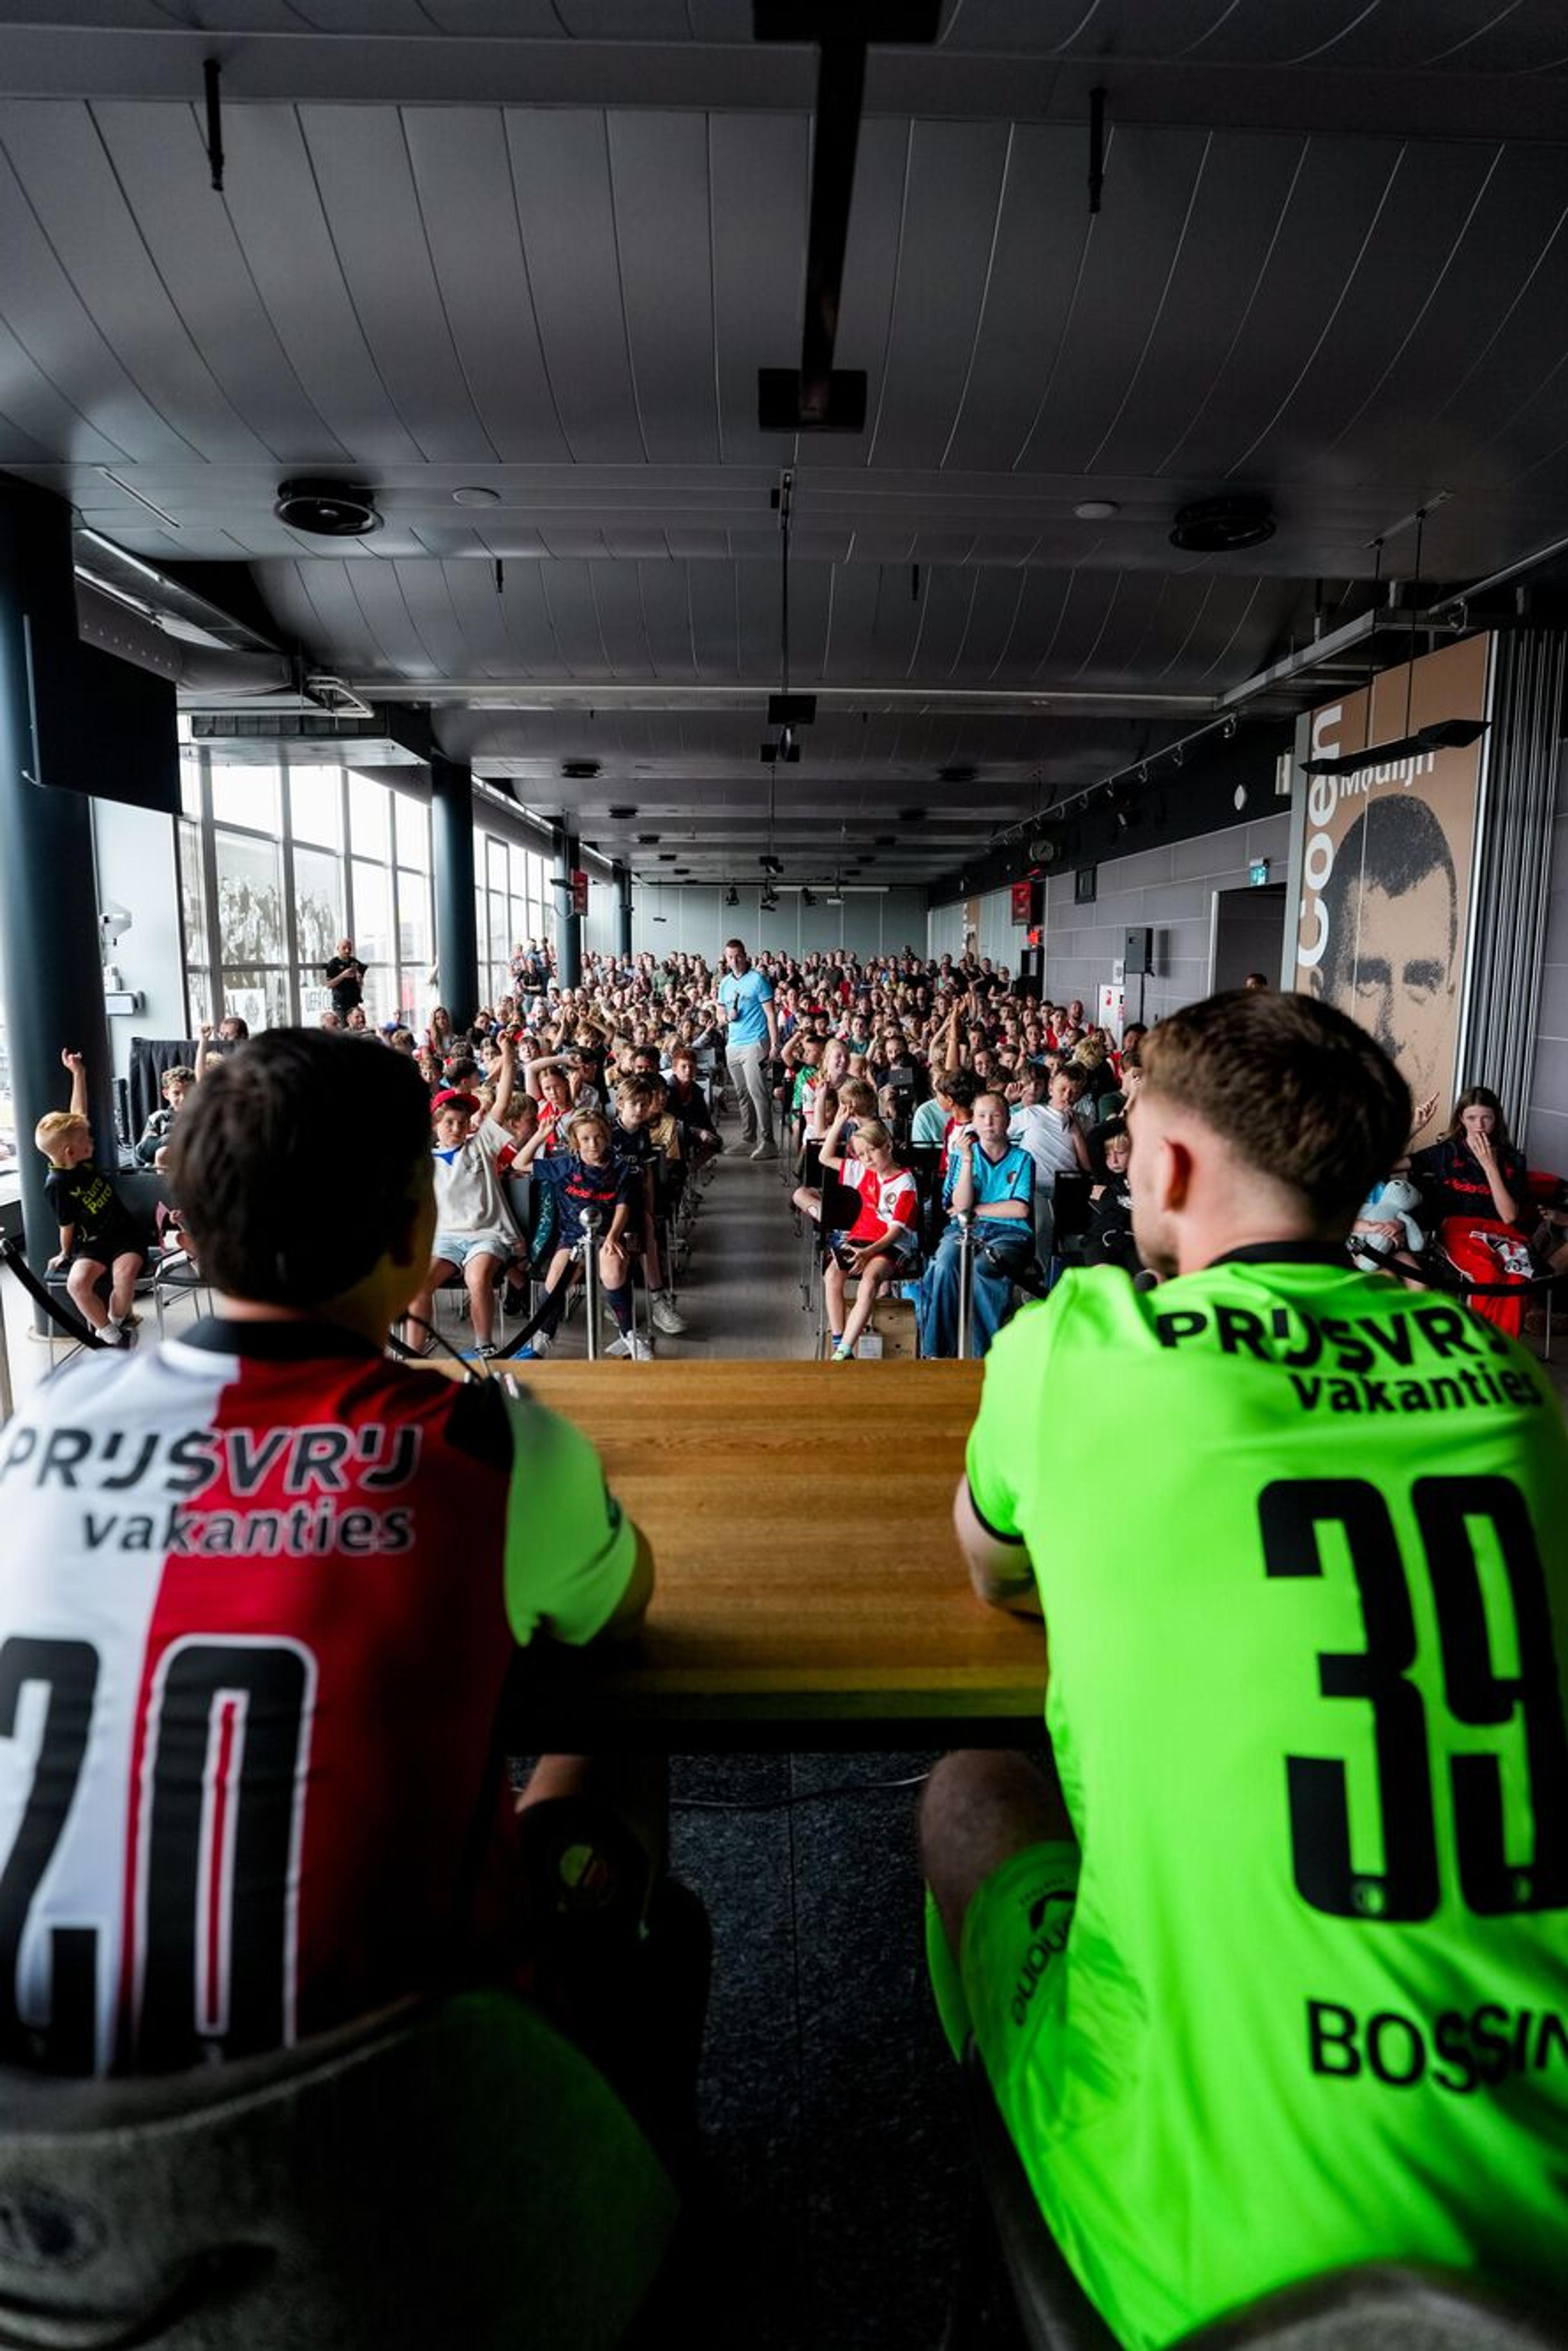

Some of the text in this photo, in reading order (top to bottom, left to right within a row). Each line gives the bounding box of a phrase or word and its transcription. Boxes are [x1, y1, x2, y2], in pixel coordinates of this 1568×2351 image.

[84, 1501, 416, 1556] vakanties
[1257, 1474, 1568, 1924] 39
[0, 1633, 318, 2080] 20
